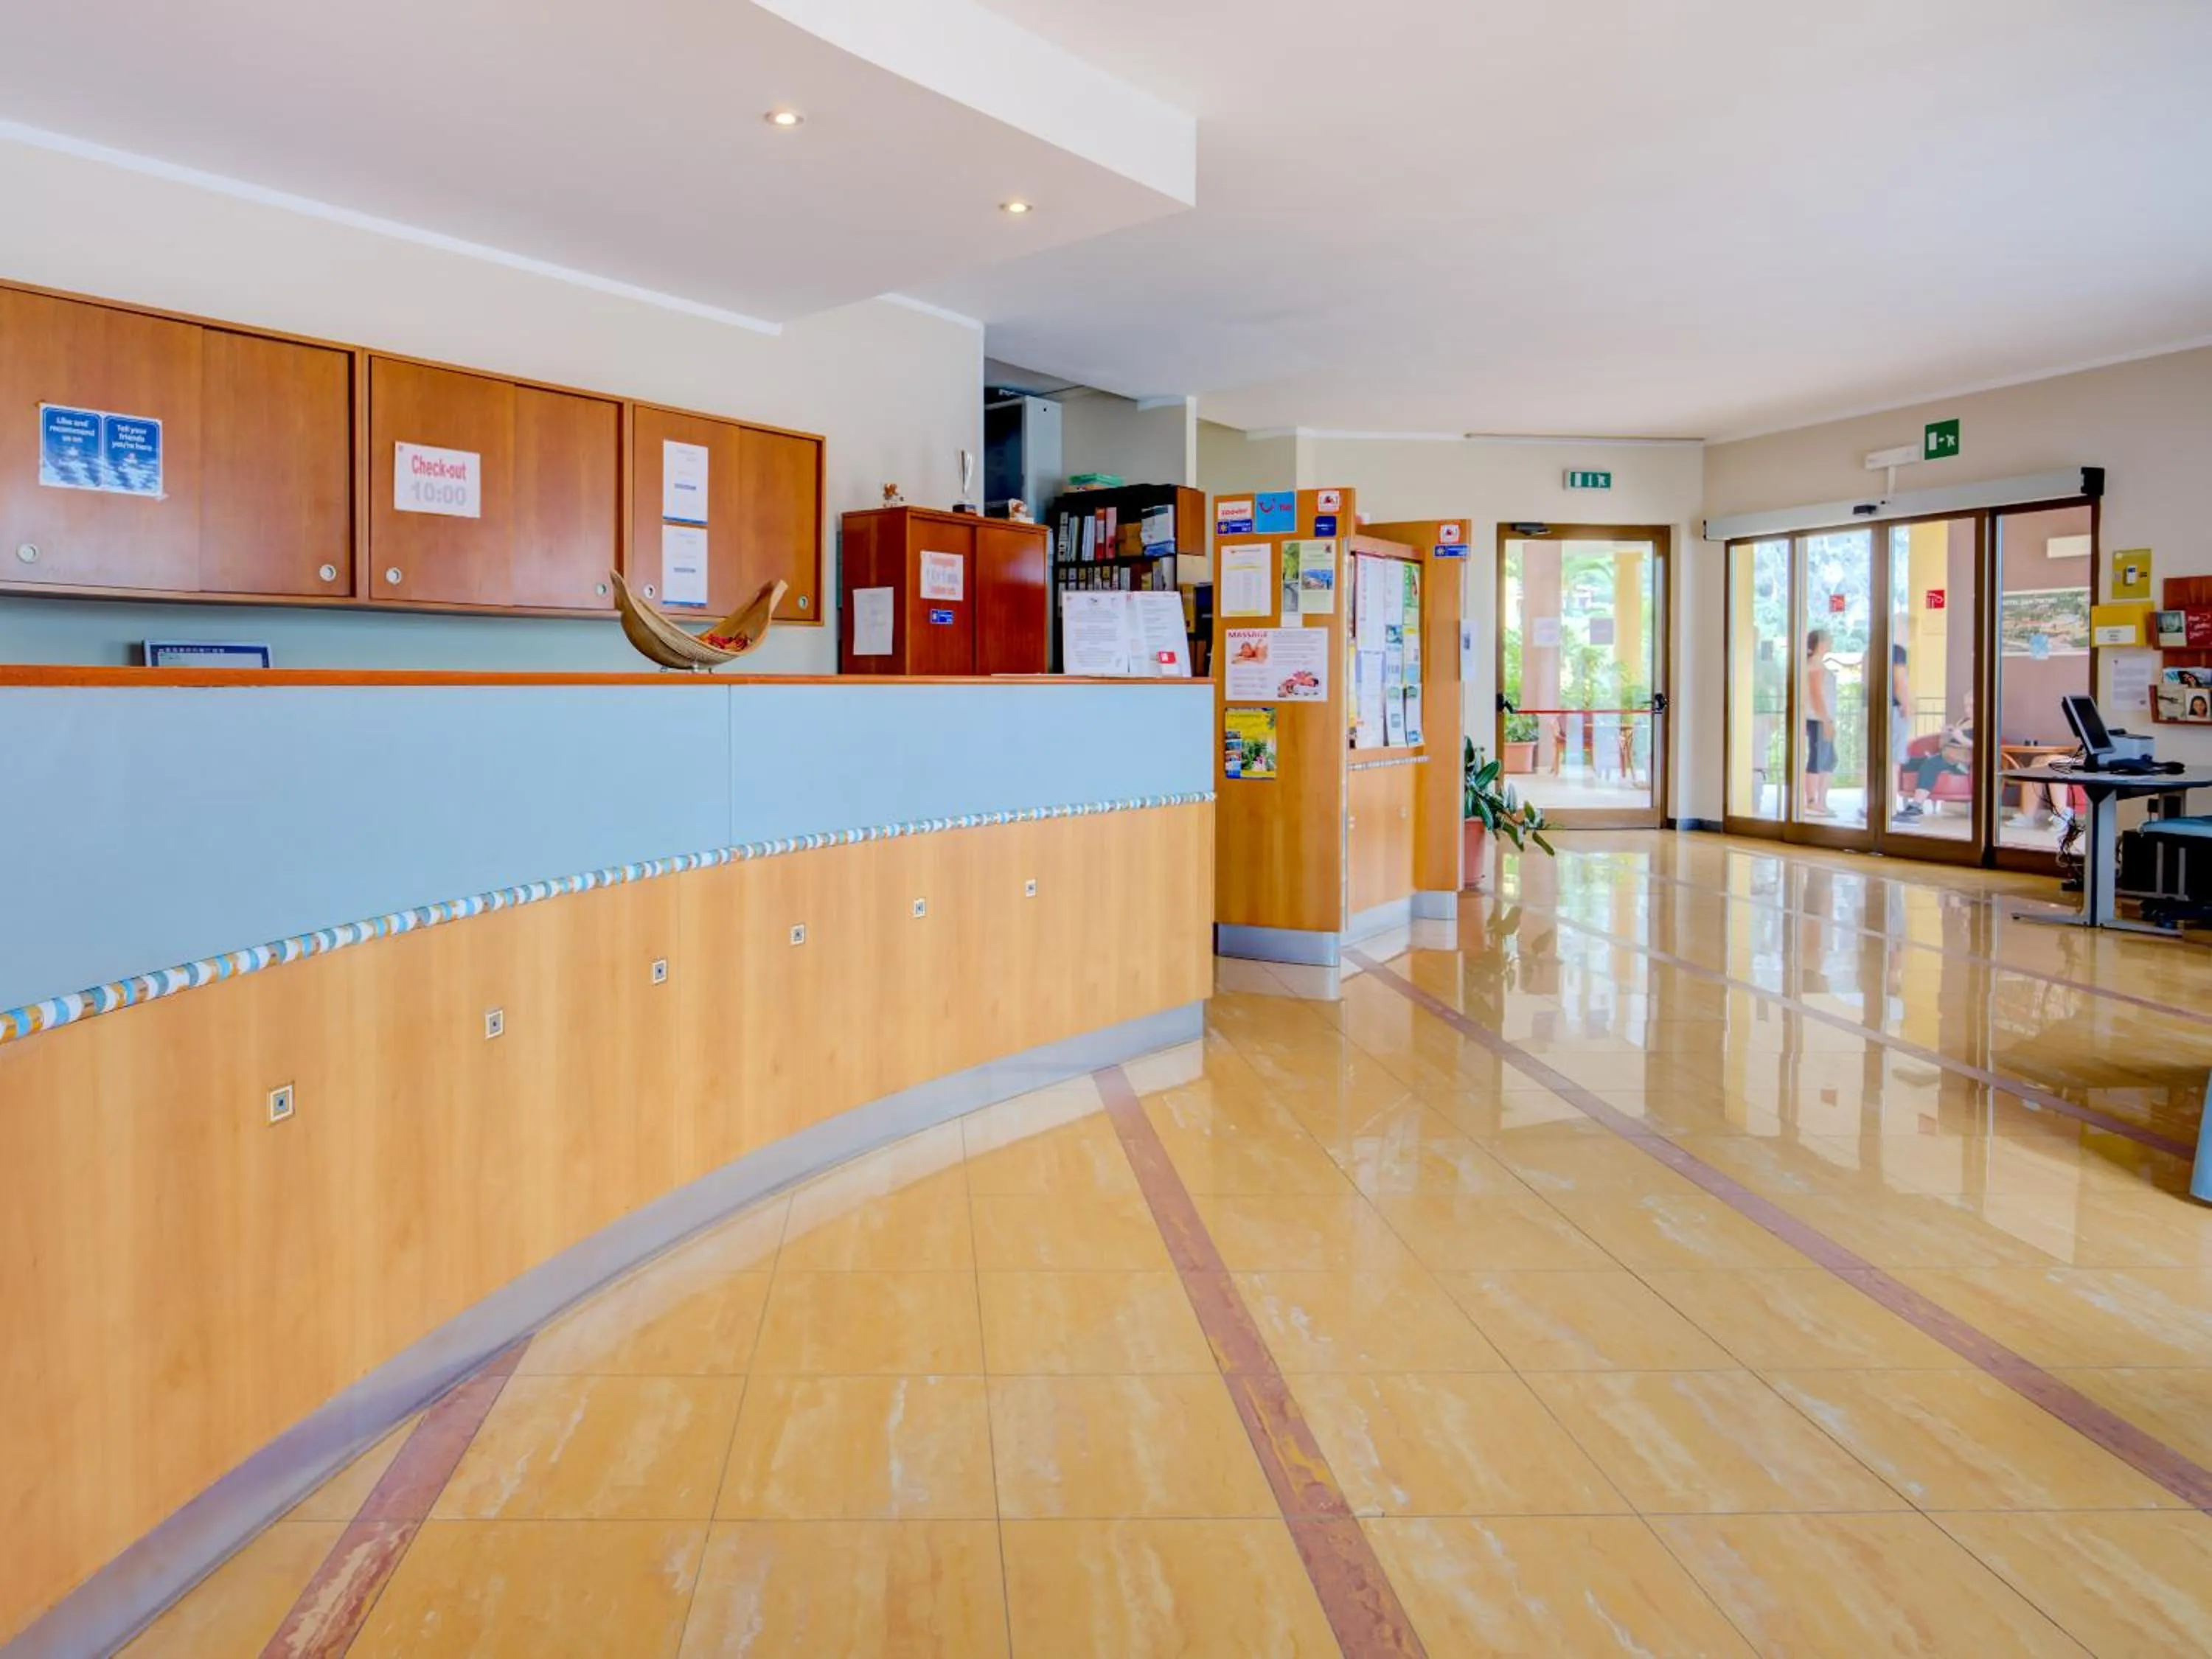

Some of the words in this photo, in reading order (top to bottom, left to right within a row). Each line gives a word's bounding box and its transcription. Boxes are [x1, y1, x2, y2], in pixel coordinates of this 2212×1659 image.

[56, 417, 72, 425] Like
[73, 418, 89, 427] and
[49, 425, 95, 437] recommend
[117, 424, 130, 433] Tell
[131, 426, 147, 436] your
[119, 433, 145, 442] friends
[135, 442, 153, 452] here
[411, 454, 467, 480] Check-out
[411, 481, 466, 505] 10:00
